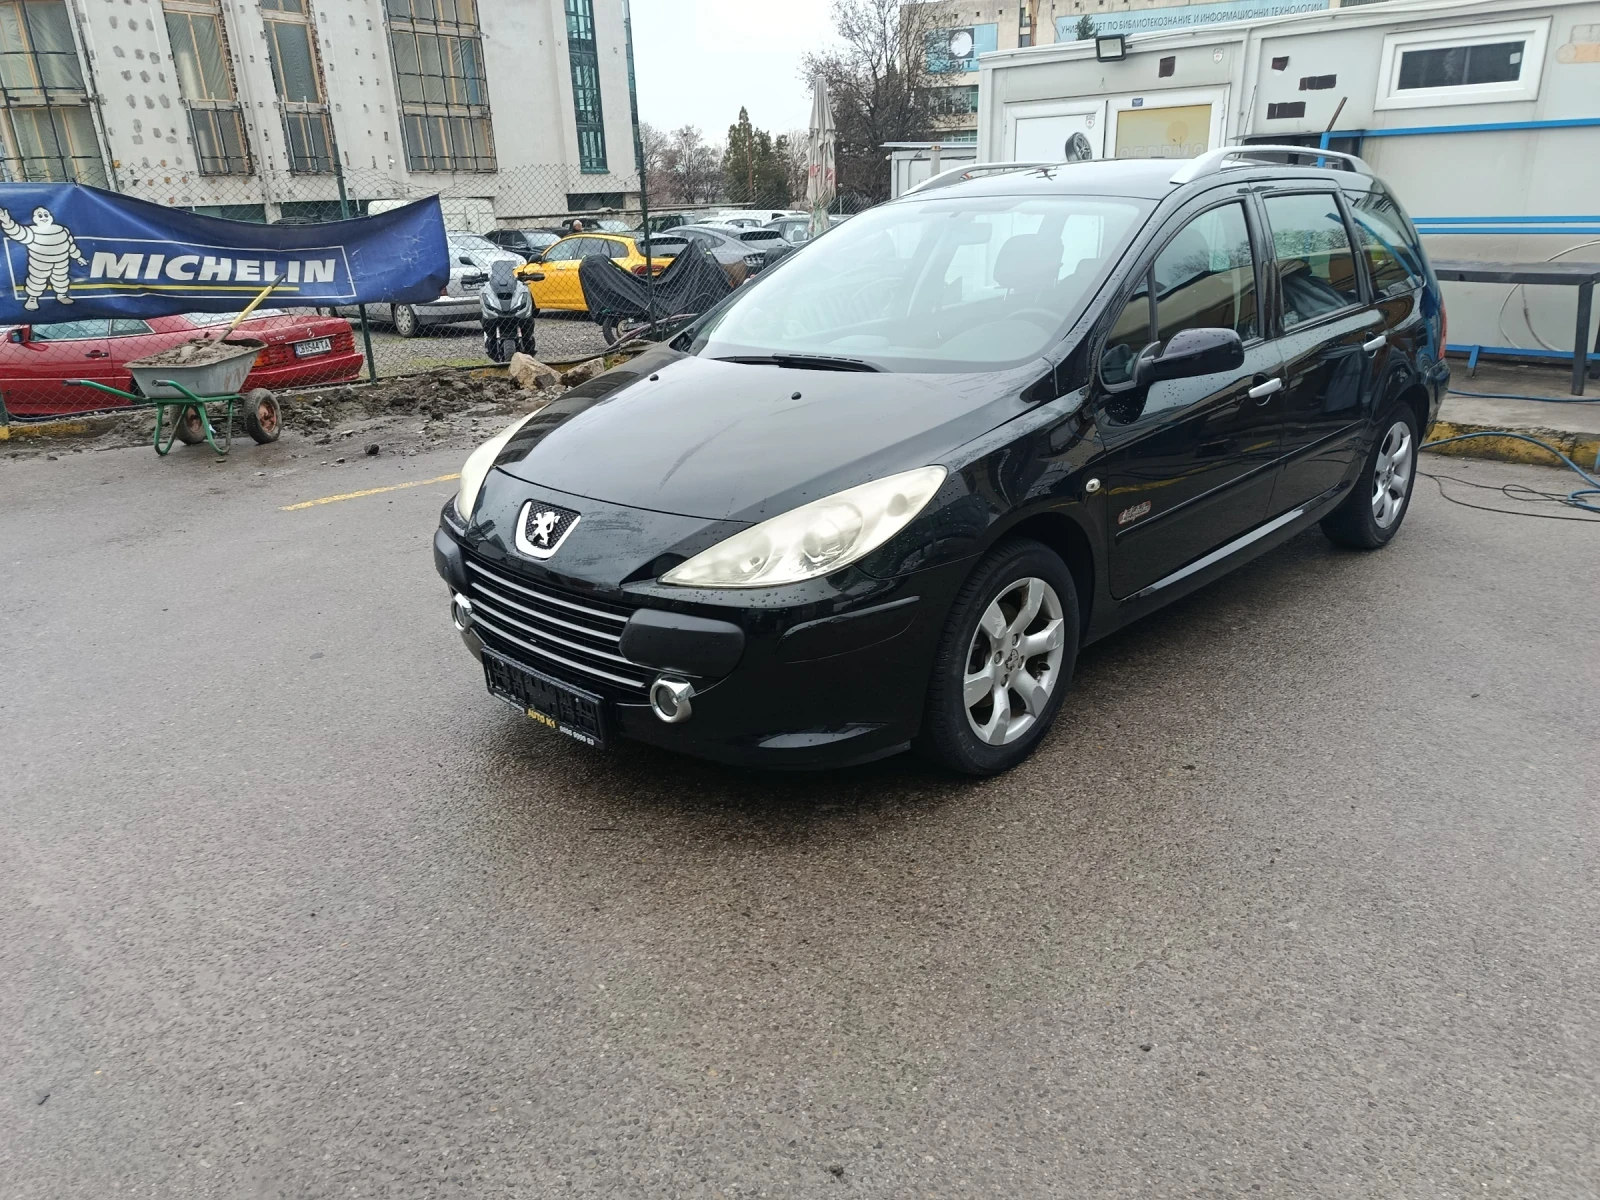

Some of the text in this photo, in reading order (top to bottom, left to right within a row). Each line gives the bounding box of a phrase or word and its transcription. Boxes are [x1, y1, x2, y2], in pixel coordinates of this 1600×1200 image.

[1061, 3, 1323, 34] УНИВИТЕТ ПО БИБЛИОТЕКОЗНАНИЕ И ИНФОРМАЦИОННИ ТЕХНОЛОГИИ
[90, 252, 336, 284] MICHELIN
